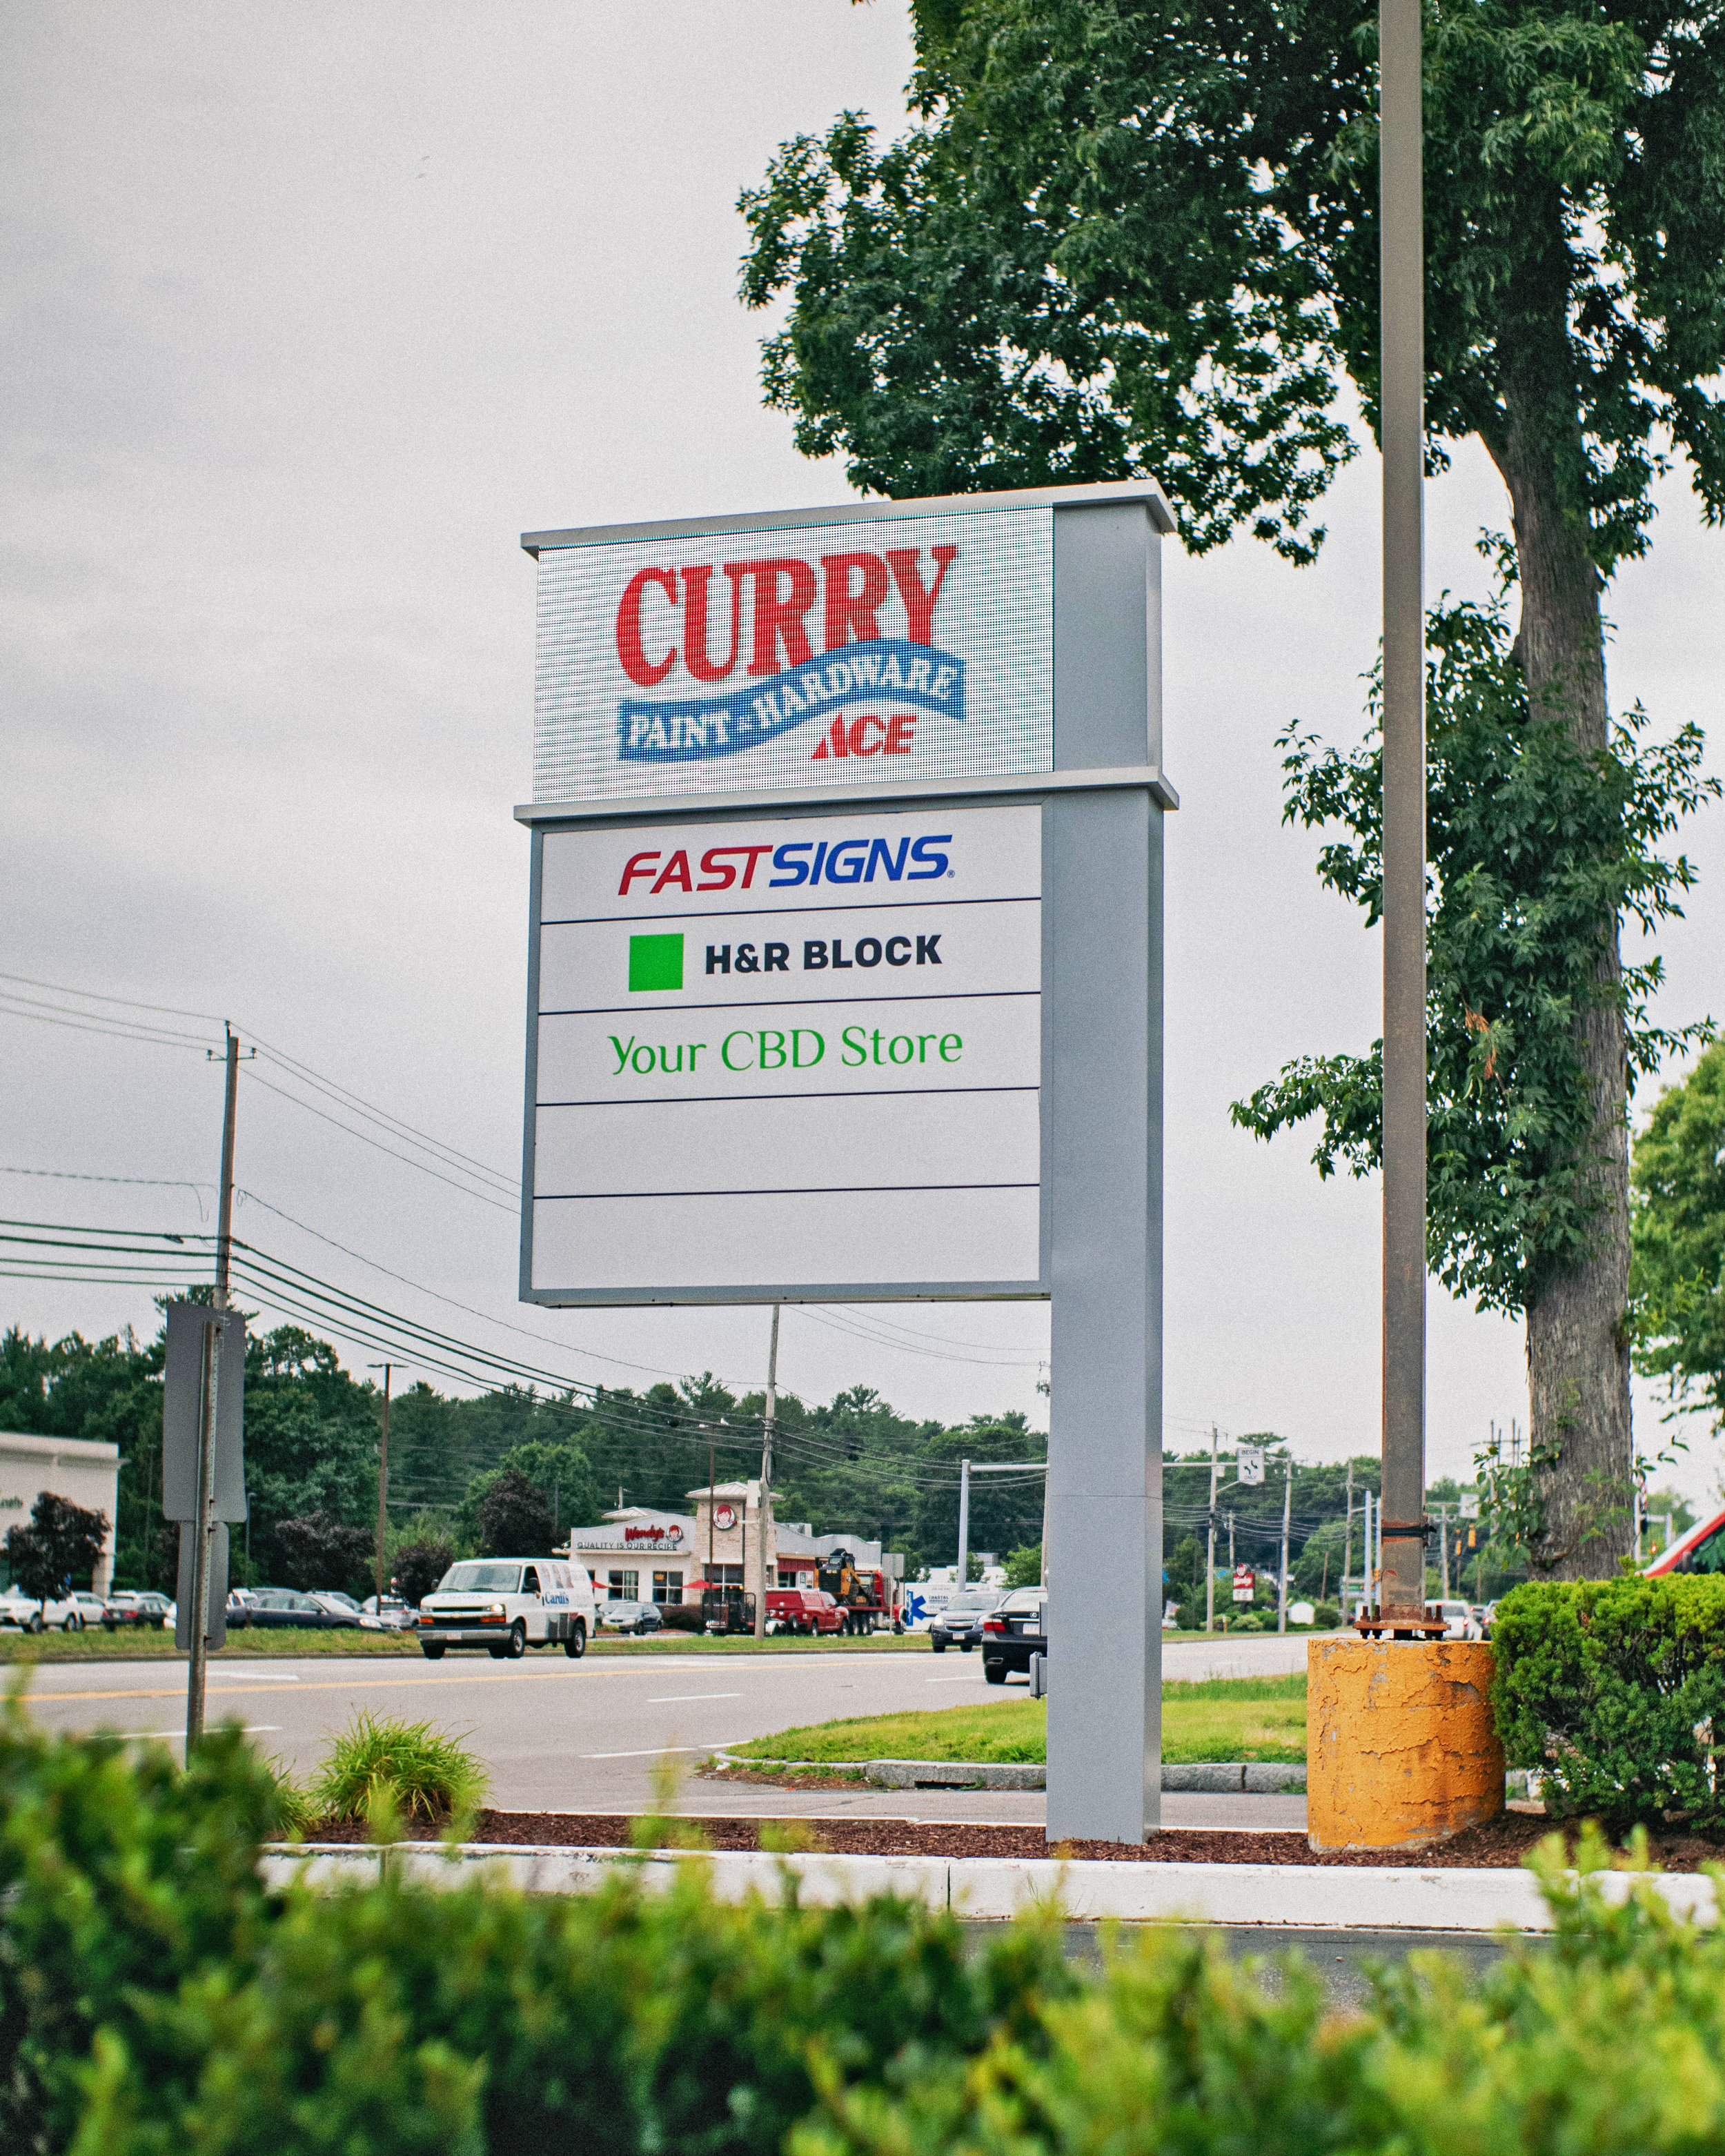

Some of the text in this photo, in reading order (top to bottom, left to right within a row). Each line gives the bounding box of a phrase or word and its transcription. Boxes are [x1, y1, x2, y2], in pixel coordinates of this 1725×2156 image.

[615, 545, 957, 686] CURRY
[627, 709, 731, 747] PAINT
[753, 655, 957, 729] HARDWARE
[811, 713, 917, 760] ACE
[705, 934, 942, 974] H&R BLOCK
[608, 1026, 963, 1075] Your CBD Store
[624, 1524, 664, 1542] Wendy's
